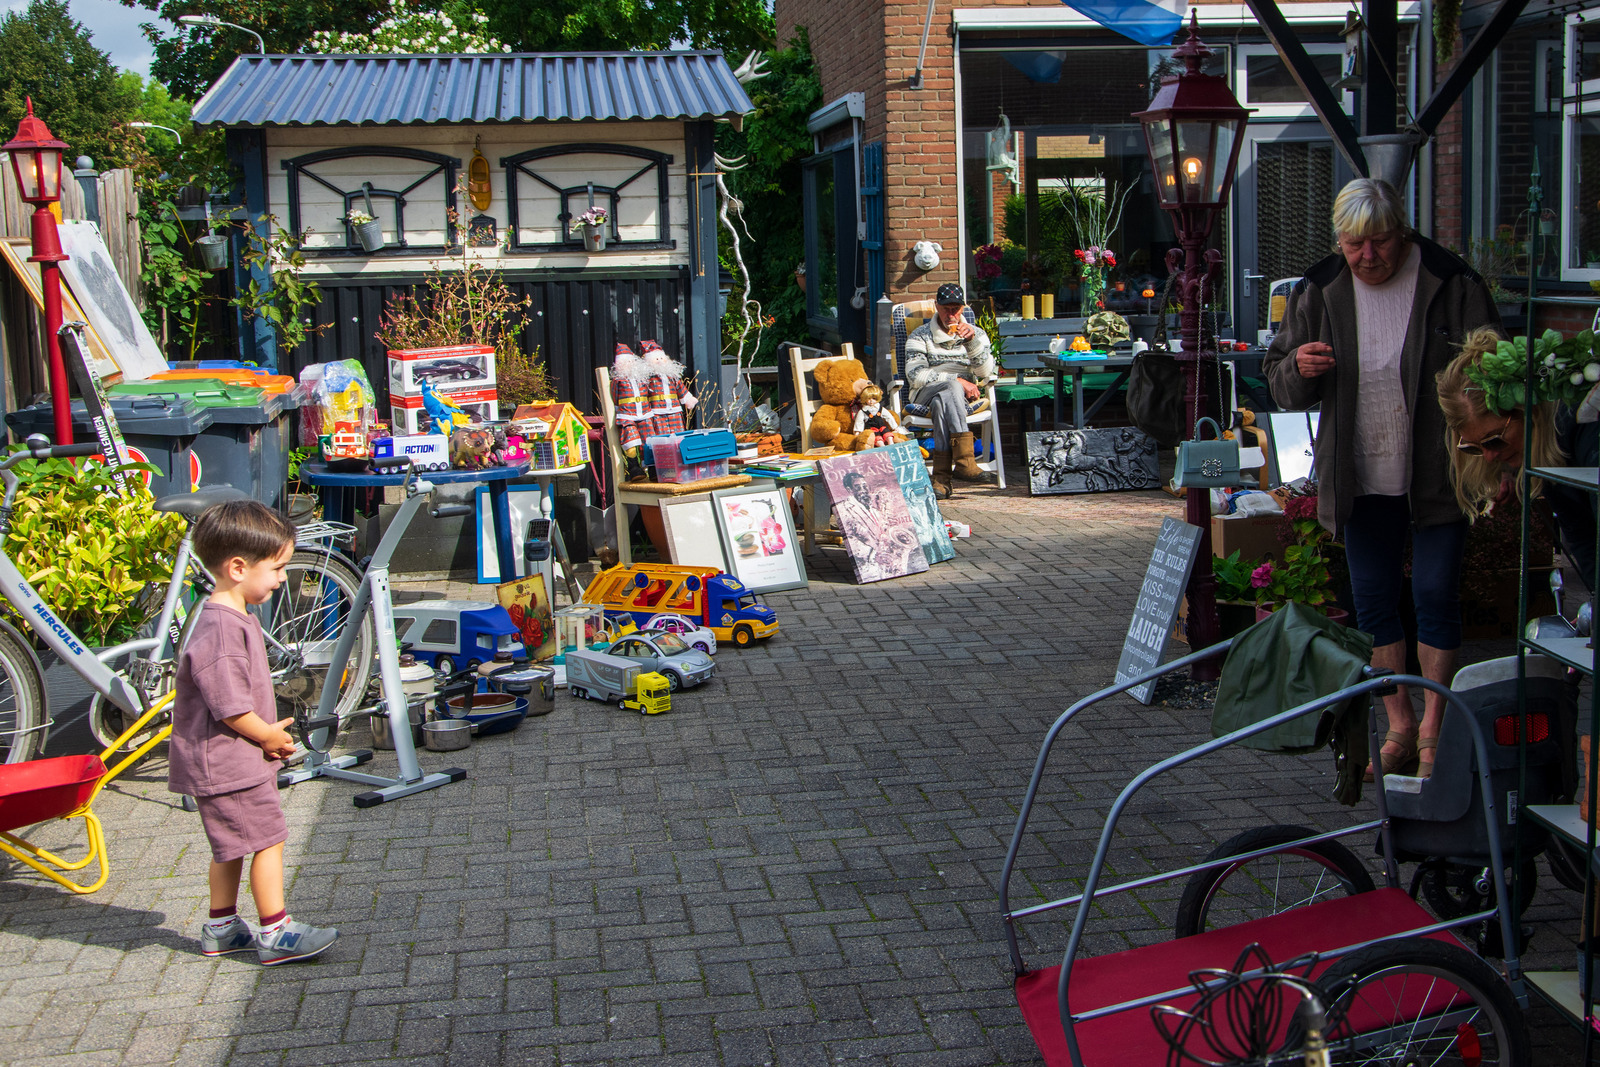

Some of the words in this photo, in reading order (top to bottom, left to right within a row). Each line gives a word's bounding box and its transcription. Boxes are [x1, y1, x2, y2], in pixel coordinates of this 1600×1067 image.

[92, 415, 115, 457] KLEMMEN
[404, 444, 435, 455] ACTION
[1159, 518, 1181, 551] Life
[1152, 548, 1165, 564] THE
[1165, 553, 1187, 572] RULES
[18, 582, 31, 598] Carina
[1142, 577, 1163, 598] KISS
[1136, 595, 1158, 616] LOVE
[1156, 608, 1171, 624] truly
[32, 603, 84, 656] HERCULES
[1127, 613, 1167, 652] LAUGH
[1128, 663, 1143, 677] and
[277, 931, 301, 948] N
